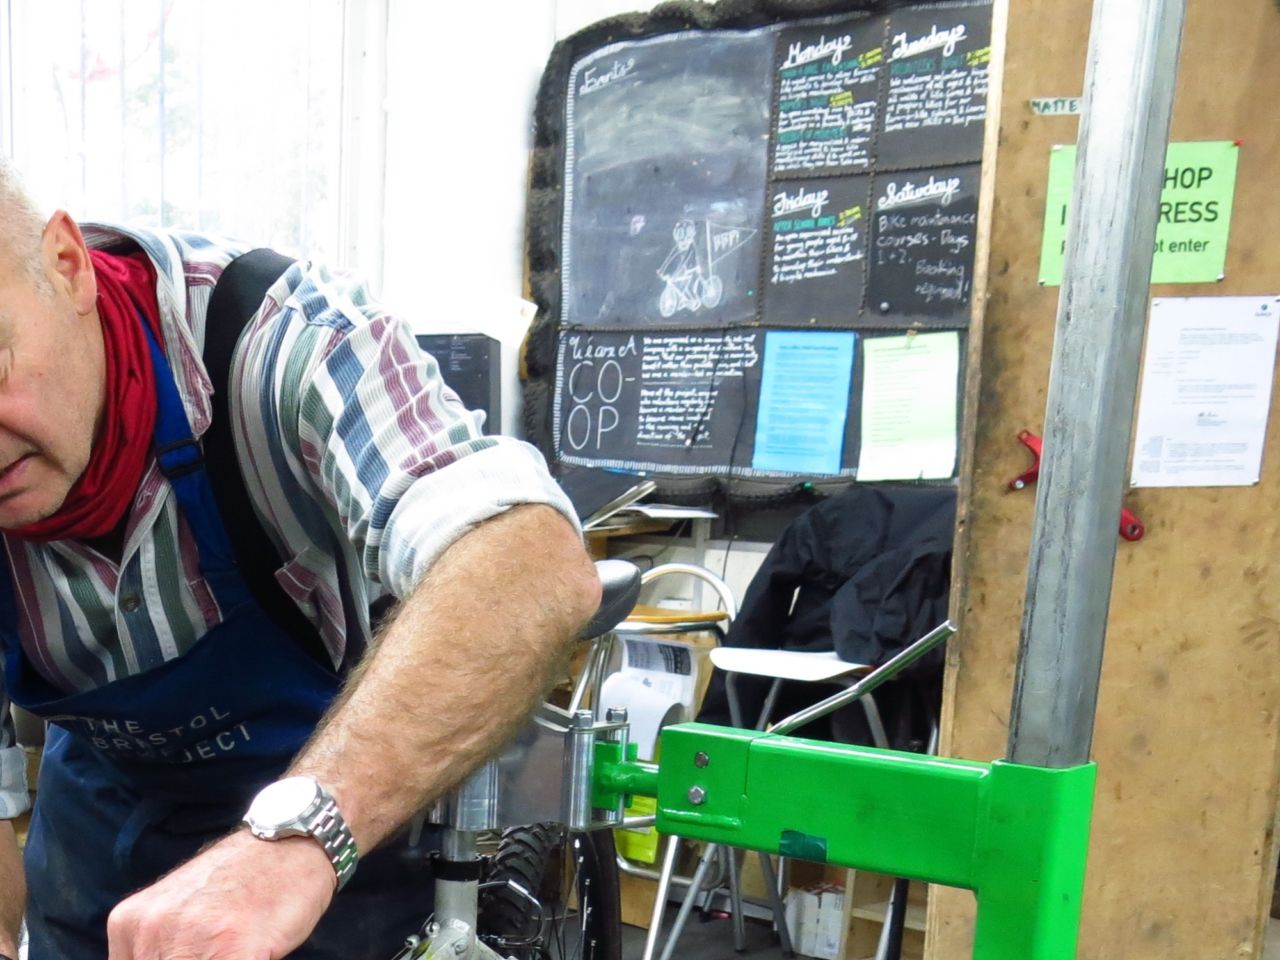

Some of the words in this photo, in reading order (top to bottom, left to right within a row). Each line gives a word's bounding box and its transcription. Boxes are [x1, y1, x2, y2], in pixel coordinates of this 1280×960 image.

[1032, 100, 1077, 112] MATTE
[1163, 167, 1213, 189] HOP
[1159, 201, 1218, 223] RESS
[879, 215, 906, 232] Bike
[876, 232, 929, 248] courses
[1169, 239, 1210, 253] enter
[568, 405, 619, 450] OP
